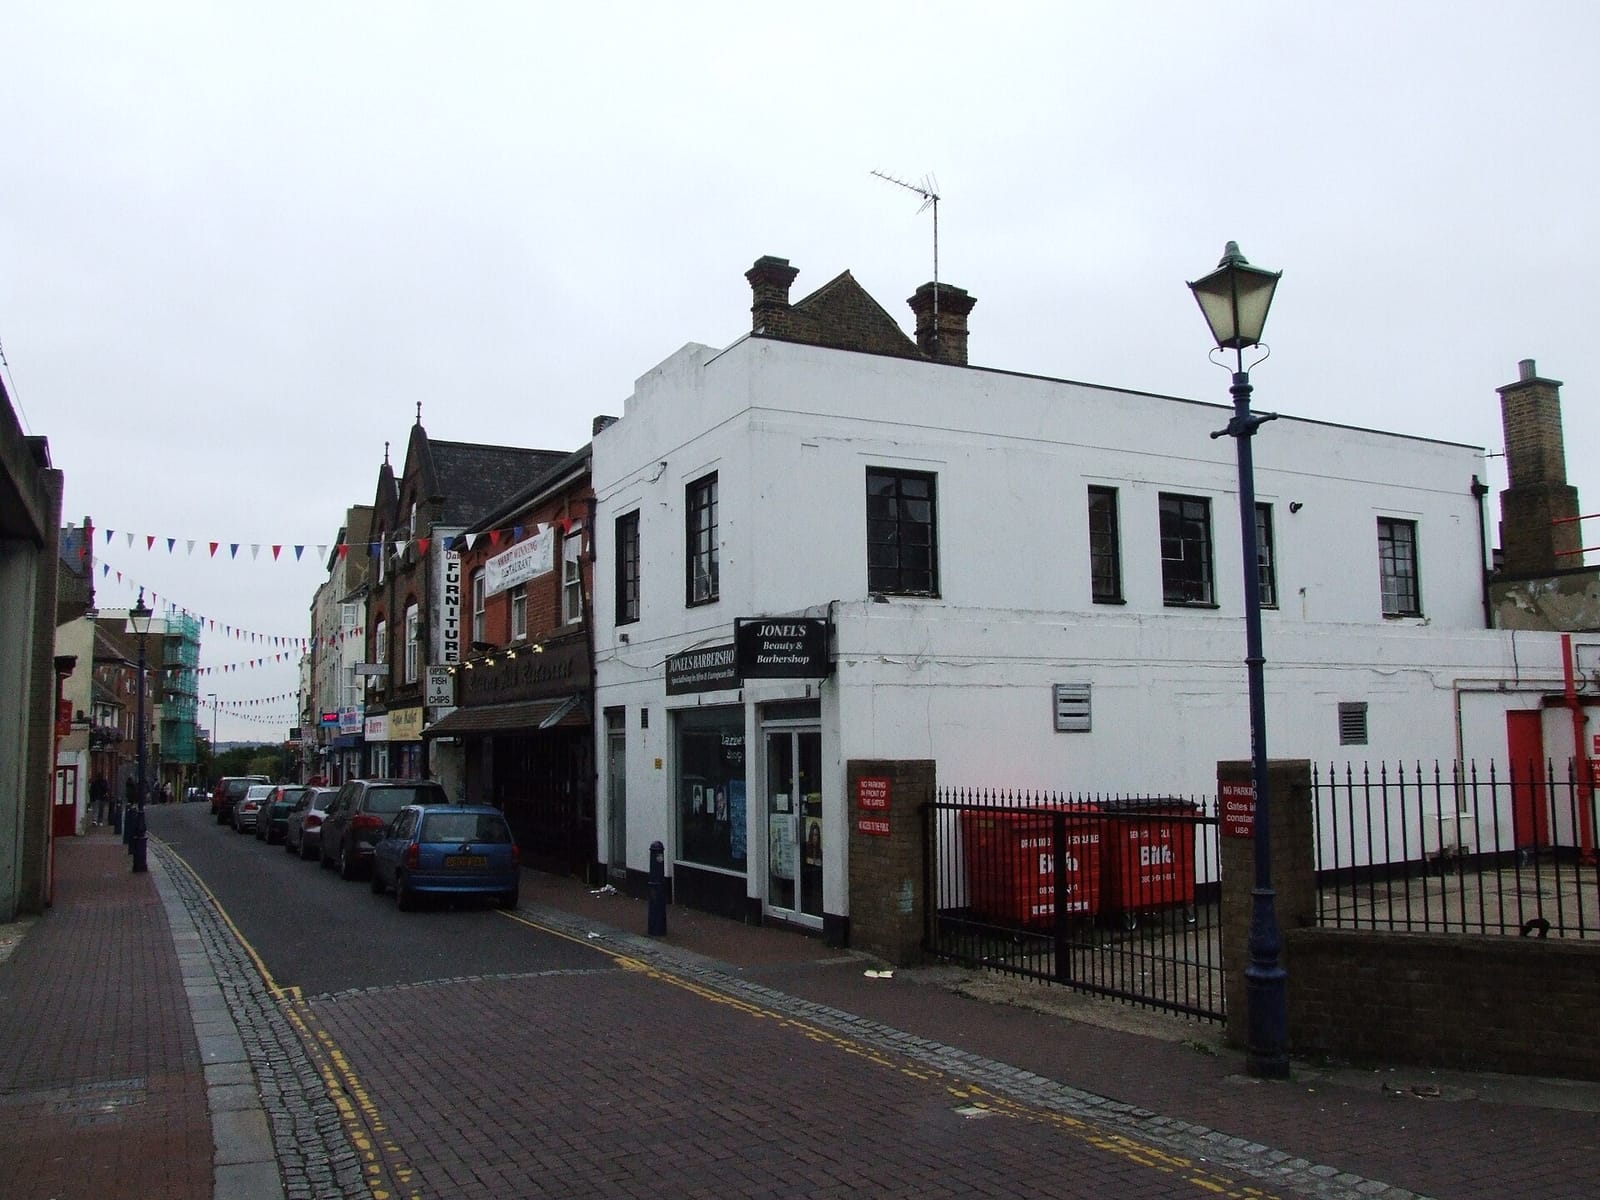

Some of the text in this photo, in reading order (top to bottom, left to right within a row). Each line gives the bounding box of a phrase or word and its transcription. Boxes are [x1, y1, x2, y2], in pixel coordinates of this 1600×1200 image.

[445, 562, 460, 662] FURNITURE
[757, 625, 807, 637] JONEL'S
[763, 641, 803, 650] Beauty &
[693, 649, 735, 669] BARBERSHO
[757, 654, 810, 664] Barbershop
[431, 676, 448, 685] FISH
[436, 686, 442, 695] &
[428, 695, 450, 704] CHIPS
[868, 781, 886, 789] PARKING
[1223, 785, 1232, 795] NO
[1226, 801, 1248, 811] Gates
[1235, 825, 1249, 834] use
